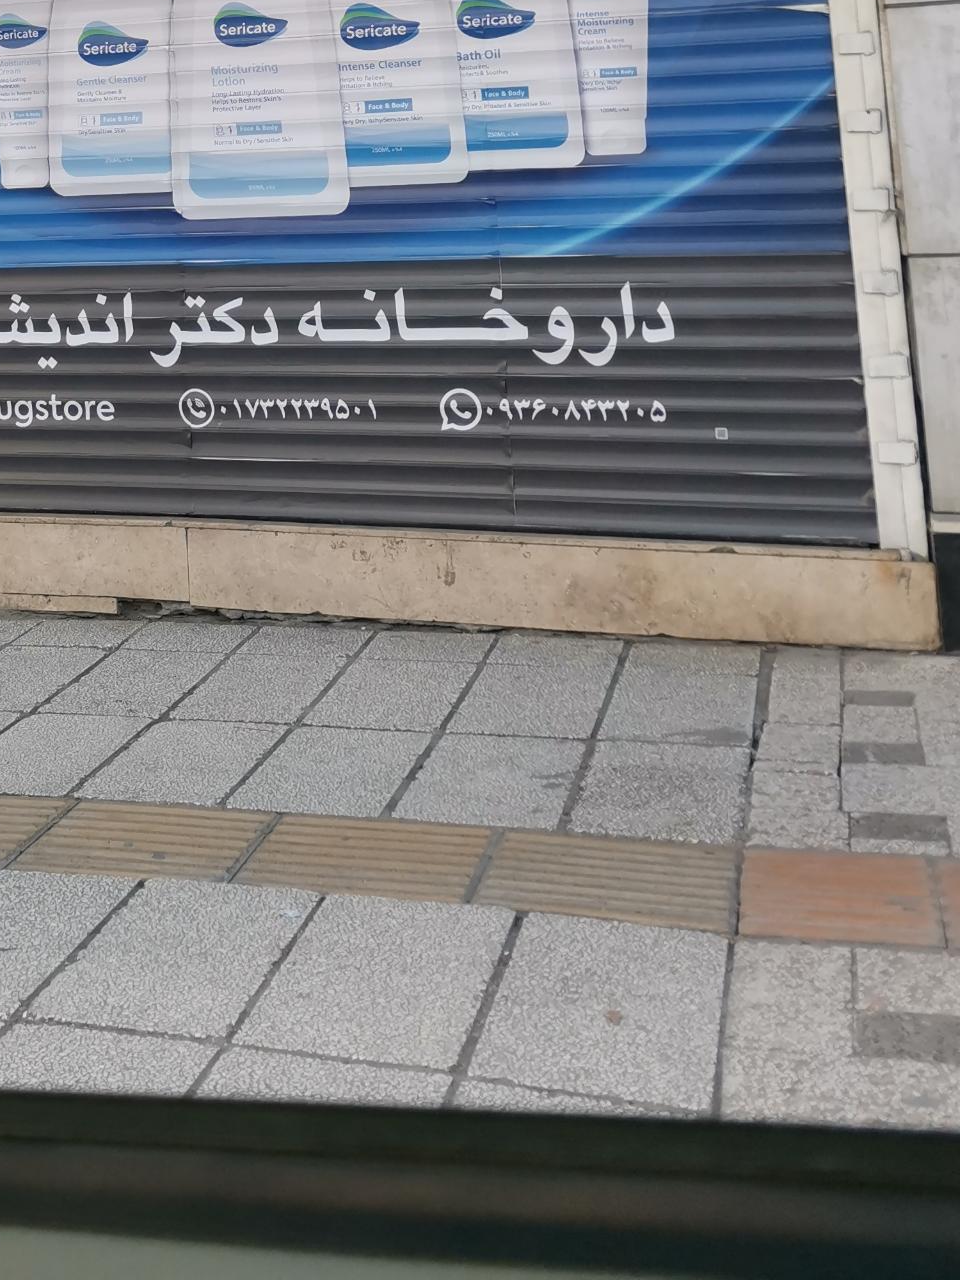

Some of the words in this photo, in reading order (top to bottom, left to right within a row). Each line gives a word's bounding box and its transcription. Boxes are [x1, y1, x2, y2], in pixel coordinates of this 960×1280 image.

[462, 13, 523, 28] Sericate
[576, 10, 609, 18] Intense
[219, 22, 276, 36] Sericate
[577, 18, 634, 27] Moisturizing
[346, 24, 407, 40] Sericate
[578, 27, 607, 36] Cream
[82, 41, 137, 56] Sericate
[456, 50, 481, 61] Bath
[484, 48, 501, 59] Oil
[210, 63, 279, 76] Moisturizing
[338, 62, 375, 71] Intense
[378, 59, 422, 69] Cleanser
[76, 75, 106, 86] Gentle
[108, 74, 147, 85] Cleanser
[212, 77, 246, 87] Lotion
[368, 103, 383, 111] Face
[391, 101, 409, 110] Body
[297, 280, 675, 366] داروخانه
[150, 295, 279, 368] دکتر
[219, 398, 378, 421] ۰۱۷۳۲۲۳۹۵۰۱
[486, 397, 667, 423] ۰۹۳۶۰۸۴۳۲۰۵
